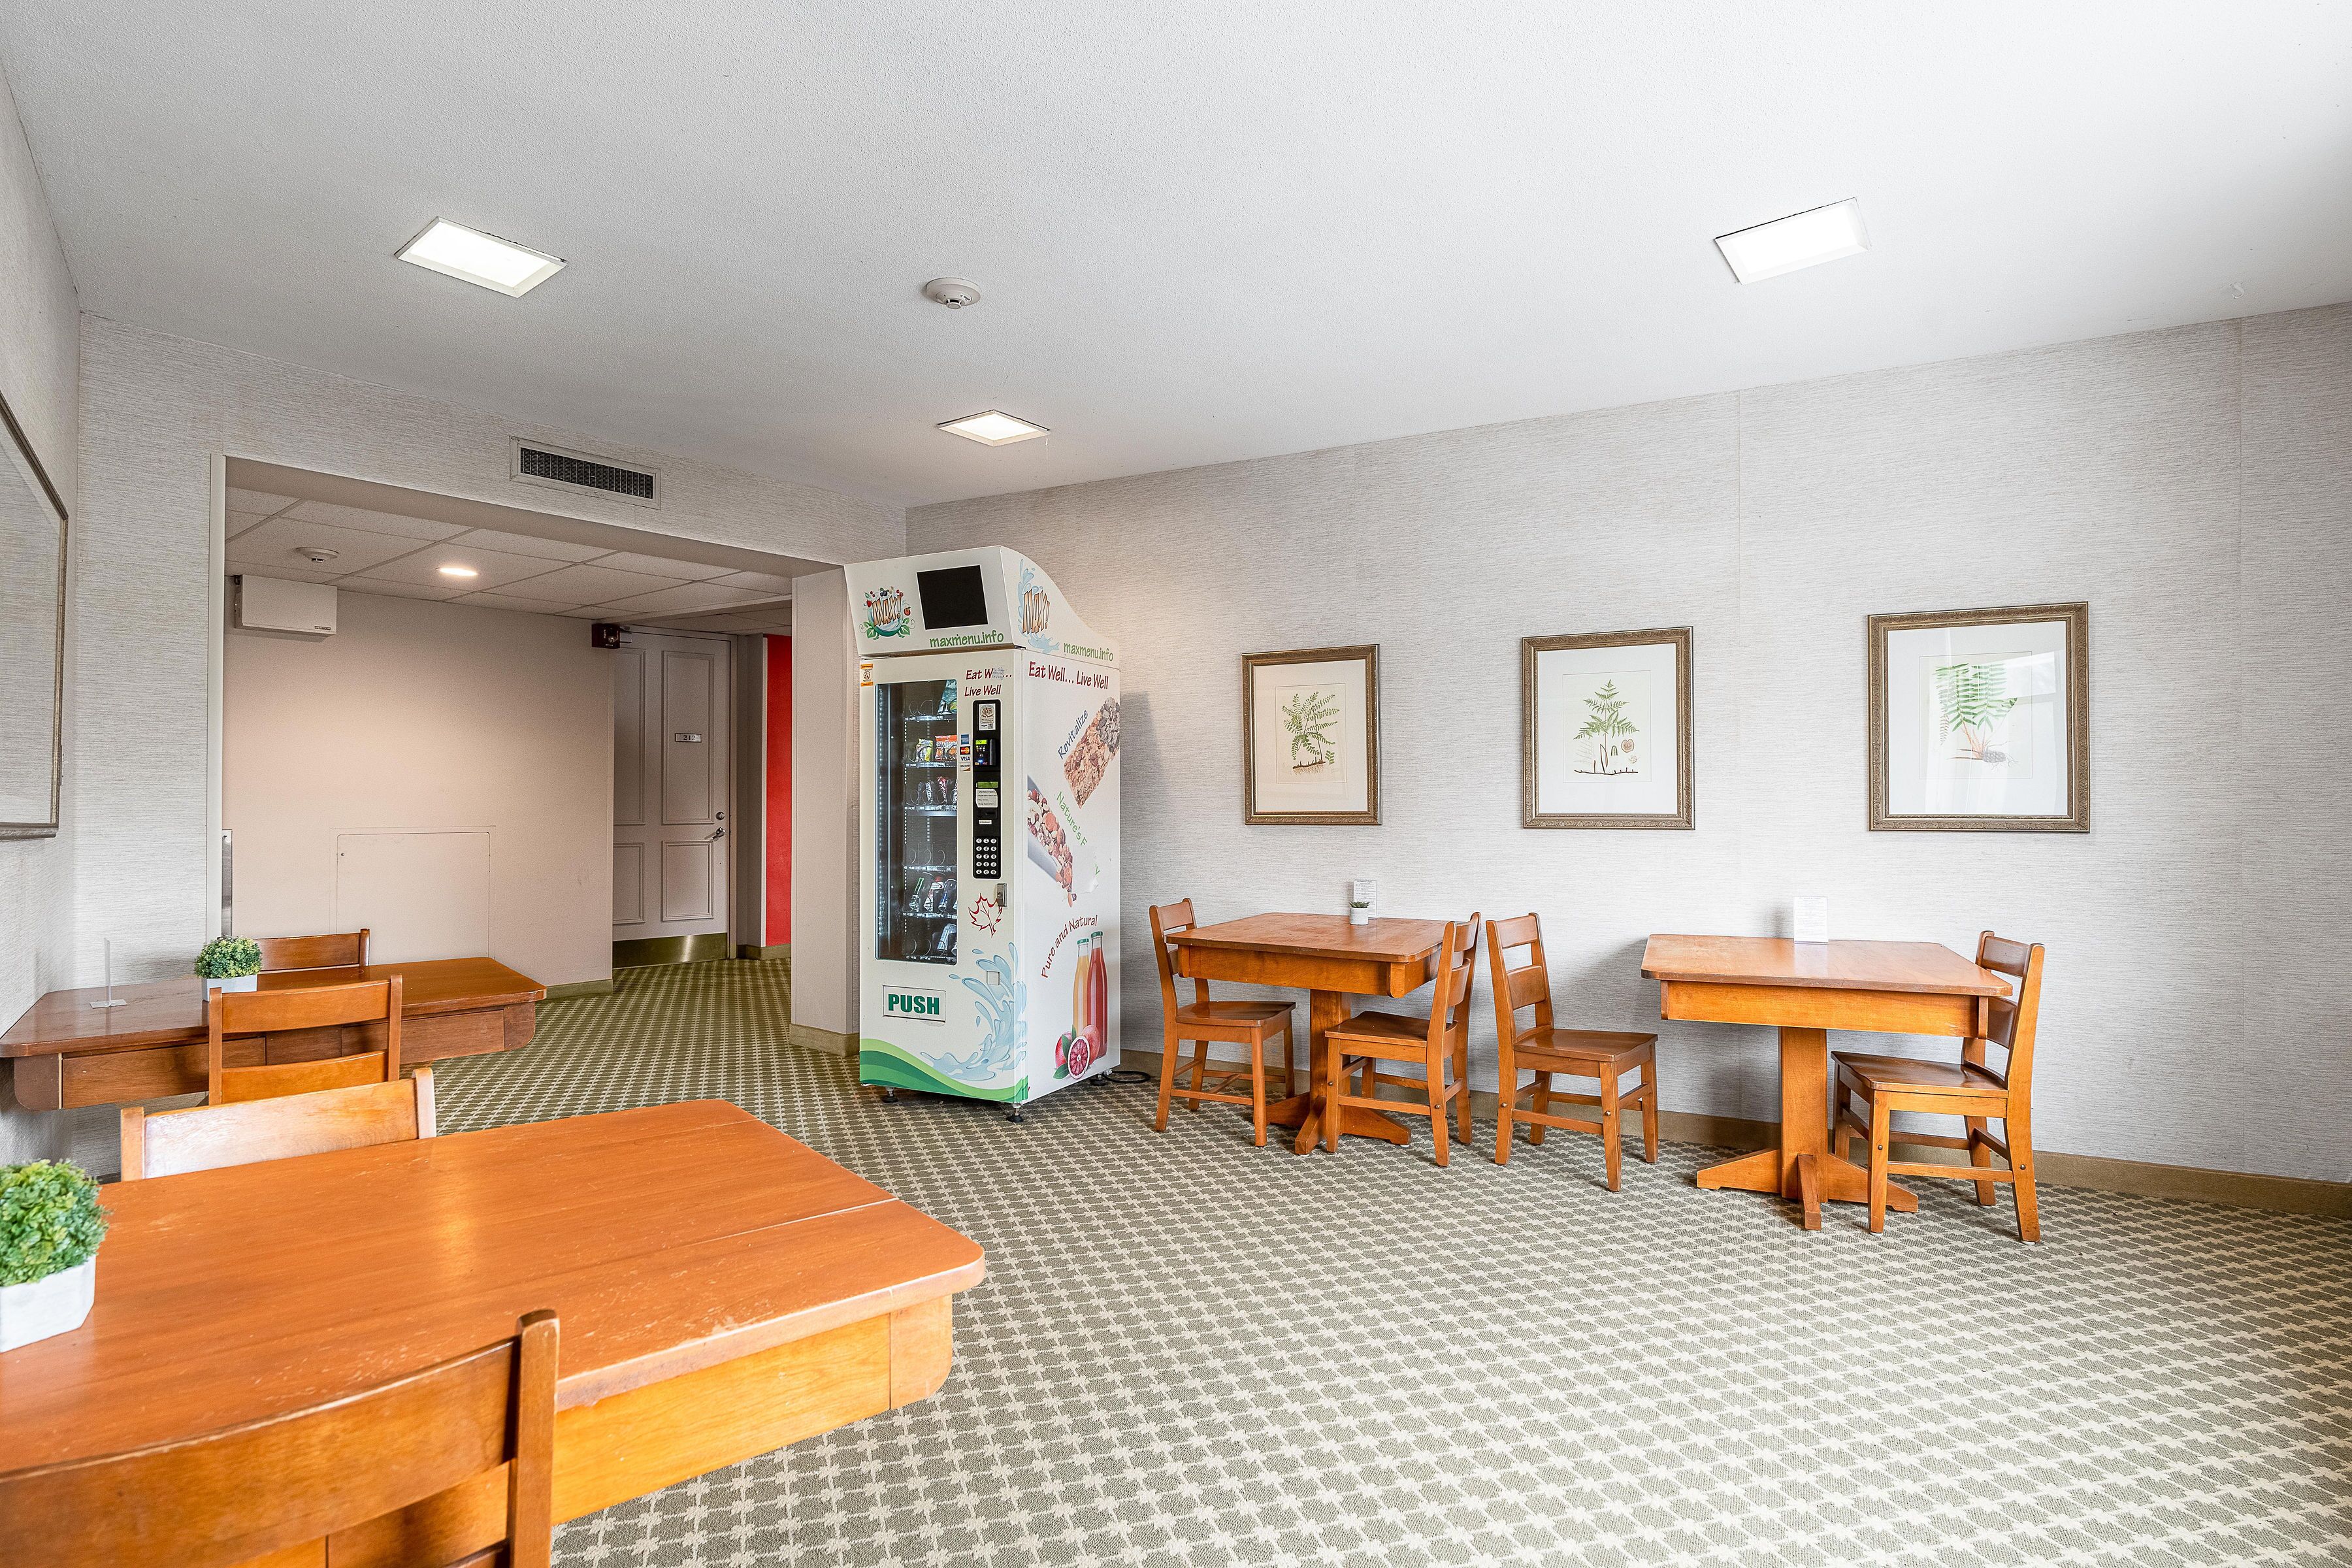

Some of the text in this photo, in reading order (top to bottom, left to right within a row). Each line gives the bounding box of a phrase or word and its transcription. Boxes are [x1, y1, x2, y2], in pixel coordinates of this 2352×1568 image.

[872, 595, 902, 627] MAX!
[1022, 589, 1050, 634] MAX!
[930, 630, 1004, 647] maxmenu.info
[1064, 643, 1113, 661] maxmenu.info
[966, 670, 982, 679] Eat
[1029, 661, 1109, 689] Eat Well... Live Well
[964, 685, 1002, 696] Live Well
[1057, 710, 1088, 760] Revitalize
[1056, 791, 1082, 841] Nature's
[1041, 915, 1098, 979] Pure and Natural
[889, 994, 939, 1015] PUSH
